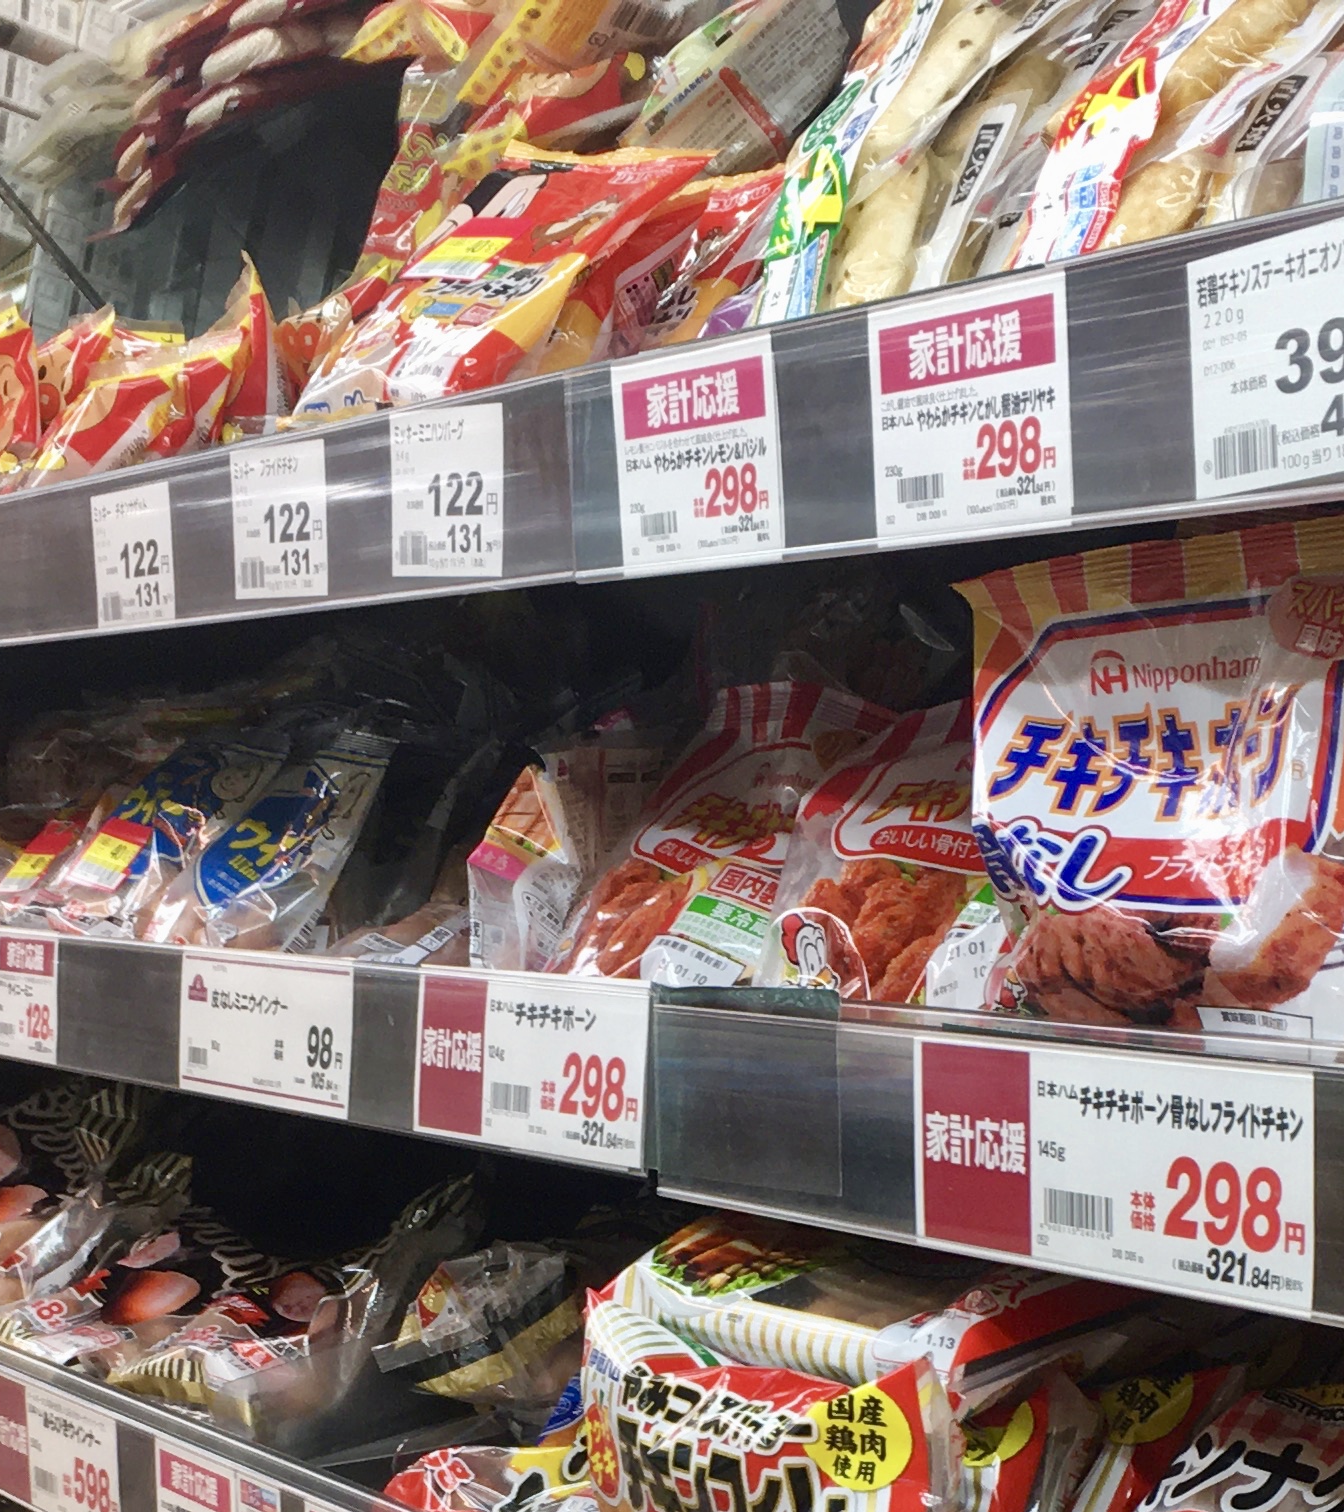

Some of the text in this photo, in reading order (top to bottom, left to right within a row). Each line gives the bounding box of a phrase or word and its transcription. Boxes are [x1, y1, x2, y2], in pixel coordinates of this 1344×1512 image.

[1204, 308, 1244, 329] 220g
[908, 311, 1022, 381] 家計応援
[646, 368, 741, 429] 家計応援
[1133, 652, 1262, 692] Nipponham
[515, 1001, 597, 1031] チキチキボーン
[422, 1027, 482, 1072] 家計応援
[1037, 1079, 1304, 1143] 日本ハム チキチキボーン骨なしフライドチキン
[925, 1111, 1026, 1175] 家計応援
[1037, 1139, 1066, 1162] 145g
[827, 1395, 889, 1429] 国産
[824, 1427, 889, 1463] 鶏肉
[170, 1458, 218, 1508] 家計応援
[830, 1456, 877, 1486] 使用
